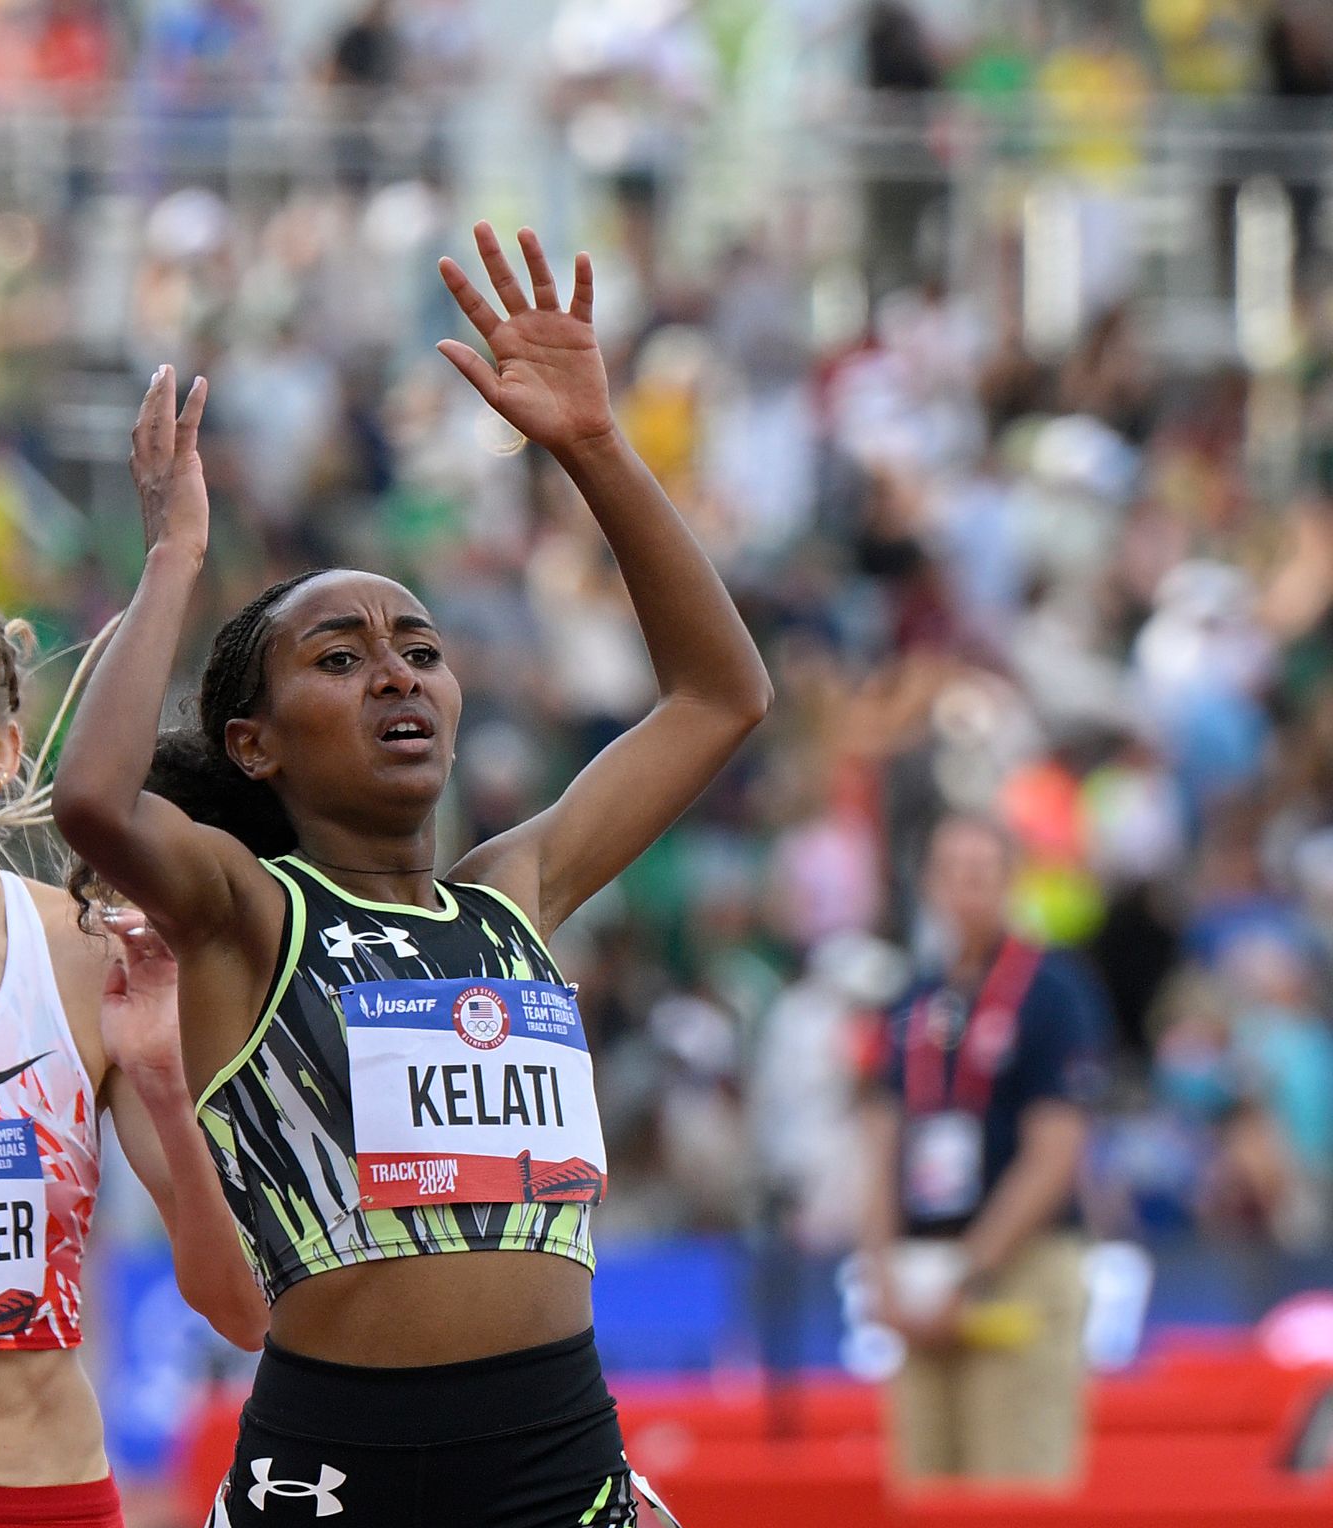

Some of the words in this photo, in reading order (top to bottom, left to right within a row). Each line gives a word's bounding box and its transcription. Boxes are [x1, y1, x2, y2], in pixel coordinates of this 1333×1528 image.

[384, 998, 438, 1014] USATF
[521, 990, 539, 1005] U.S.
[522, 1006, 550, 1021] TEAM
[550, 1007, 576, 1026] TRIALS
[526, 1021, 548, 1033] TRACK
[553, 1024, 568, 1035] FIELD
[407, 1063, 565, 1128] KELATI
[370, 1159, 459, 1183] TRACKTOWN
[418, 1176, 456, 1196] 2024
